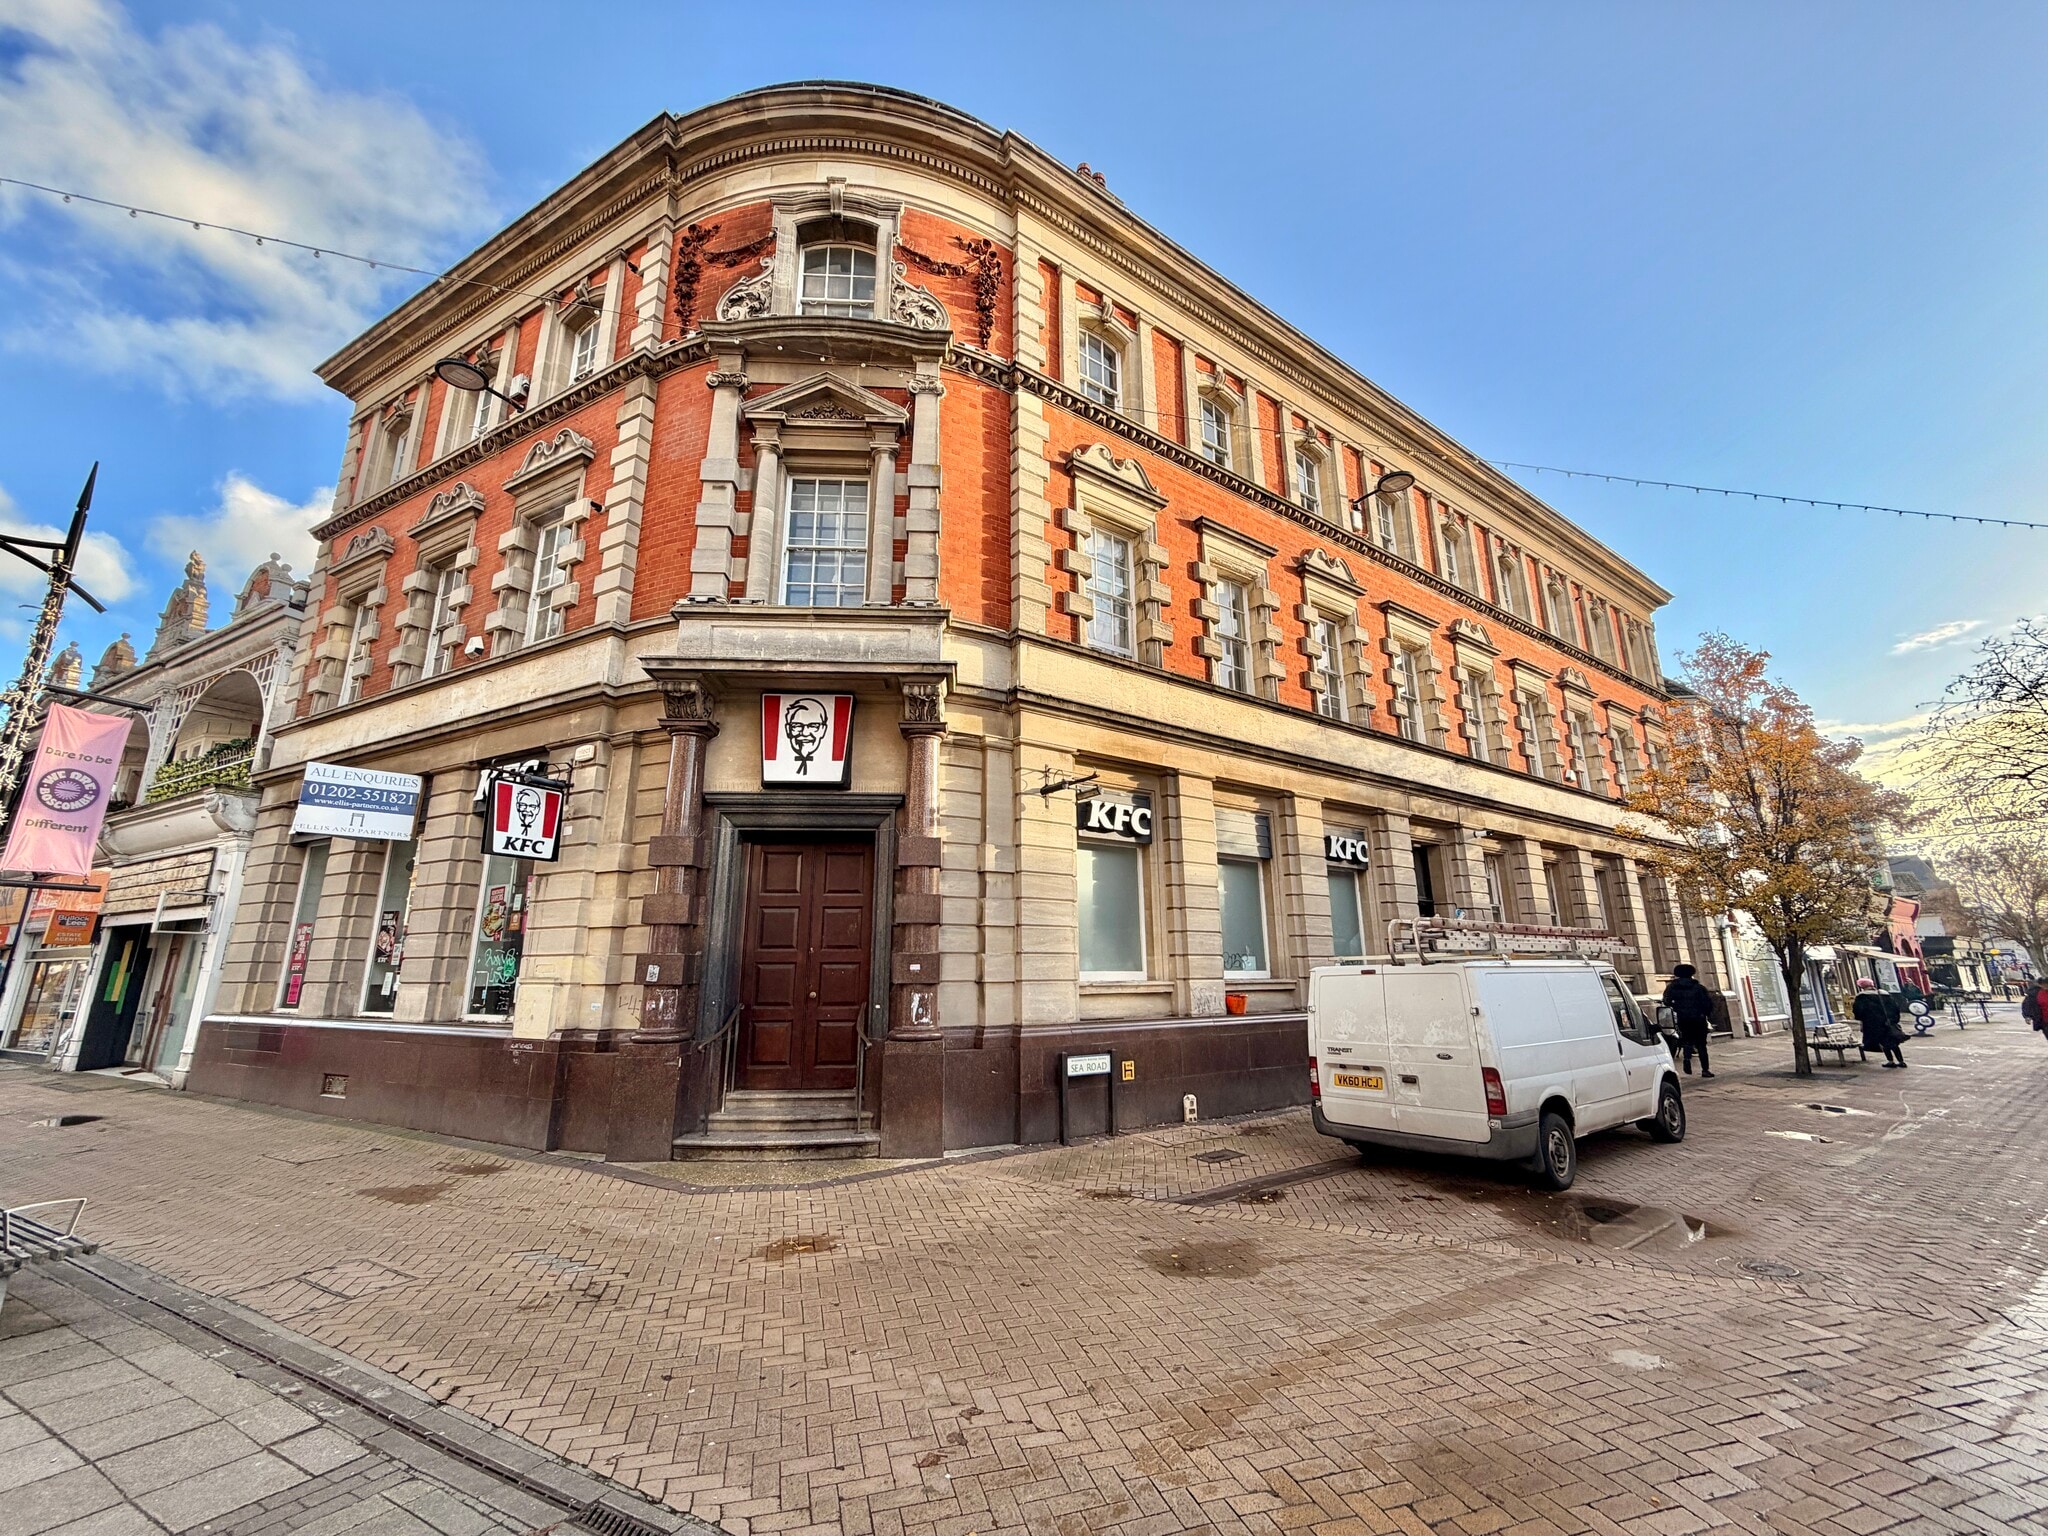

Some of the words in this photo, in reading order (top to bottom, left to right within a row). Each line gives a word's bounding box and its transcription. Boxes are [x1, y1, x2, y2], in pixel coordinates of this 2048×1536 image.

[45, 746, 76, 759] Dare
[78, 753, 93, 762] to
[95, 755, 113, 764] be
[42, 770, 67, 785] WE
[69, 771, 96, 790] ARE
[310, 766, 340, 779] ALL
[343, 770, 419, 789] ENQUIRIES
[39, 787, 95, 810] BOSCOMBE
[308, 783, 414, 805] 01202-551821
[314, 798, 400, 812] www.ellis-partners.co.uk
[25, 818, 88, 833] Different
[1087, 799, 1152, 836] KFC
[299, 823, 331, 831] ELLIS
[331, 825, 355, 833] AND
[358, 828, 409, 838] PARTNERS
[502, 836, 545, 855] KFC
[1329, 835, 1369, 863] KFC
[57, 914, 89, 922] Bullock
[1071, 1063, 1084, 1073] SEA
[1086, 1061, 1108, 1072] ROAD
[1361, 1077, 1379, 1088] HCJ
